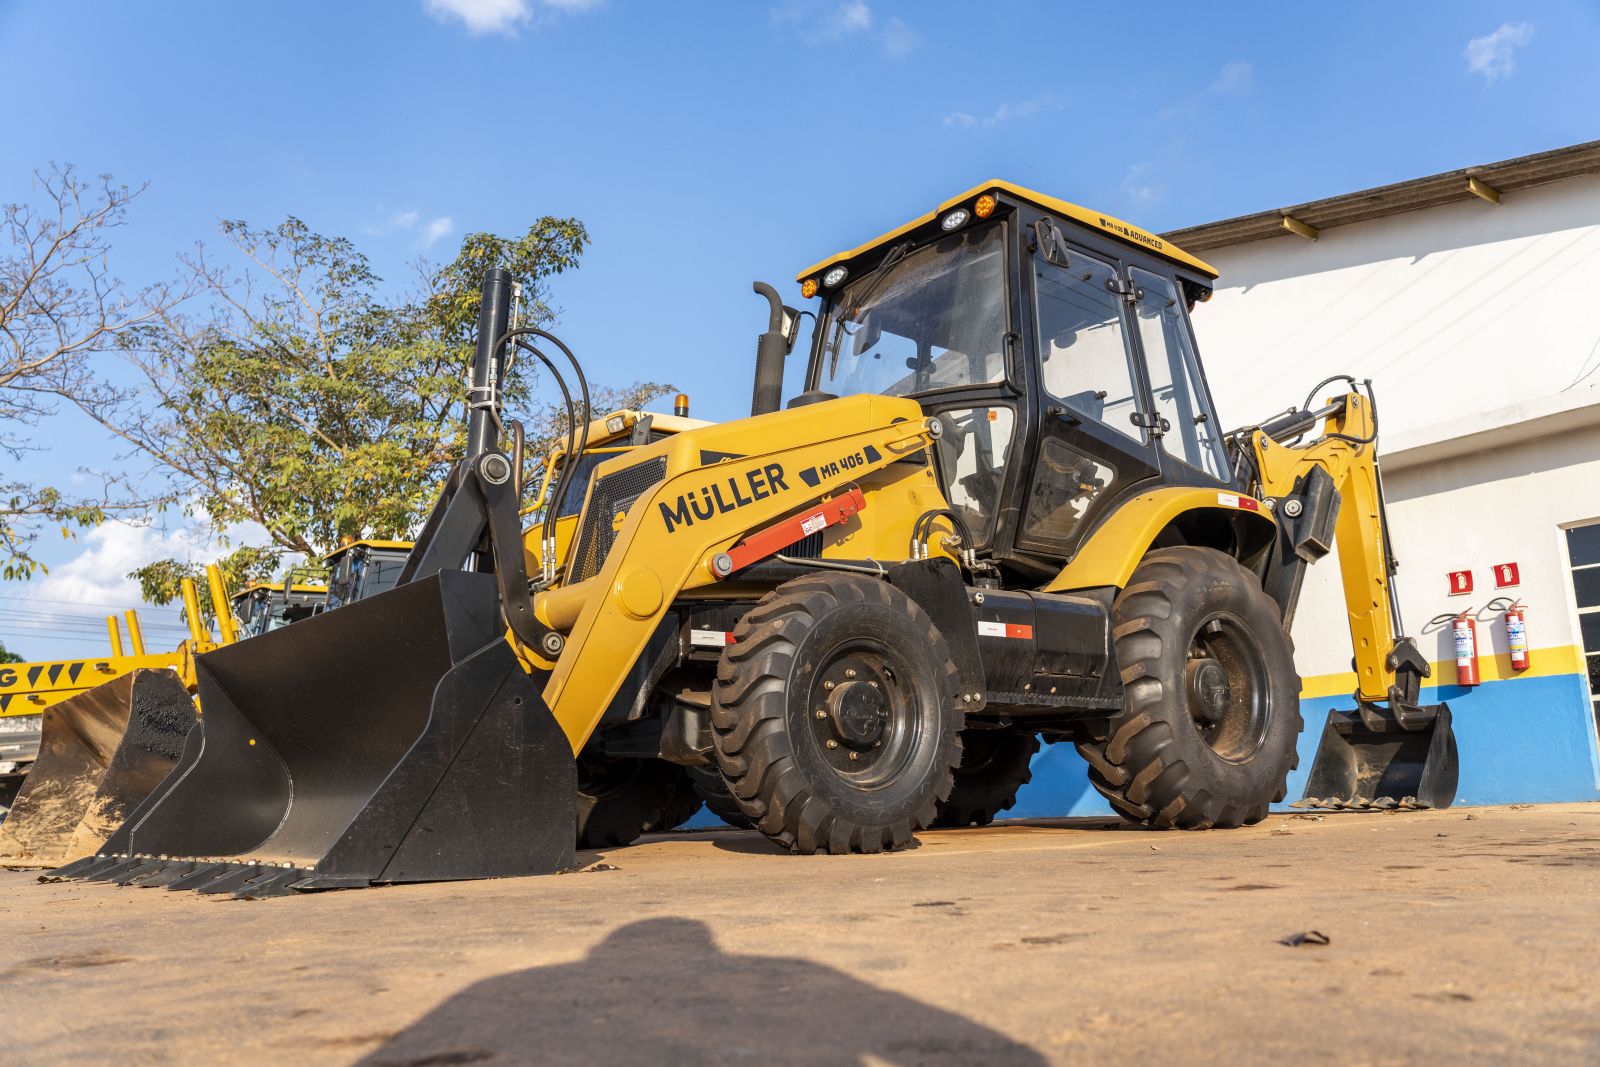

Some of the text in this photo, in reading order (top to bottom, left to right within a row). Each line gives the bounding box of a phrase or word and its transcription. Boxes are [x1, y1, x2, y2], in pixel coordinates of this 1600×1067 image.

[1131, 231, 1162, 249] ADVANCED
[819, 452, 864, 479] MR 406
[658, 463, 789, 533] MÜLLER
